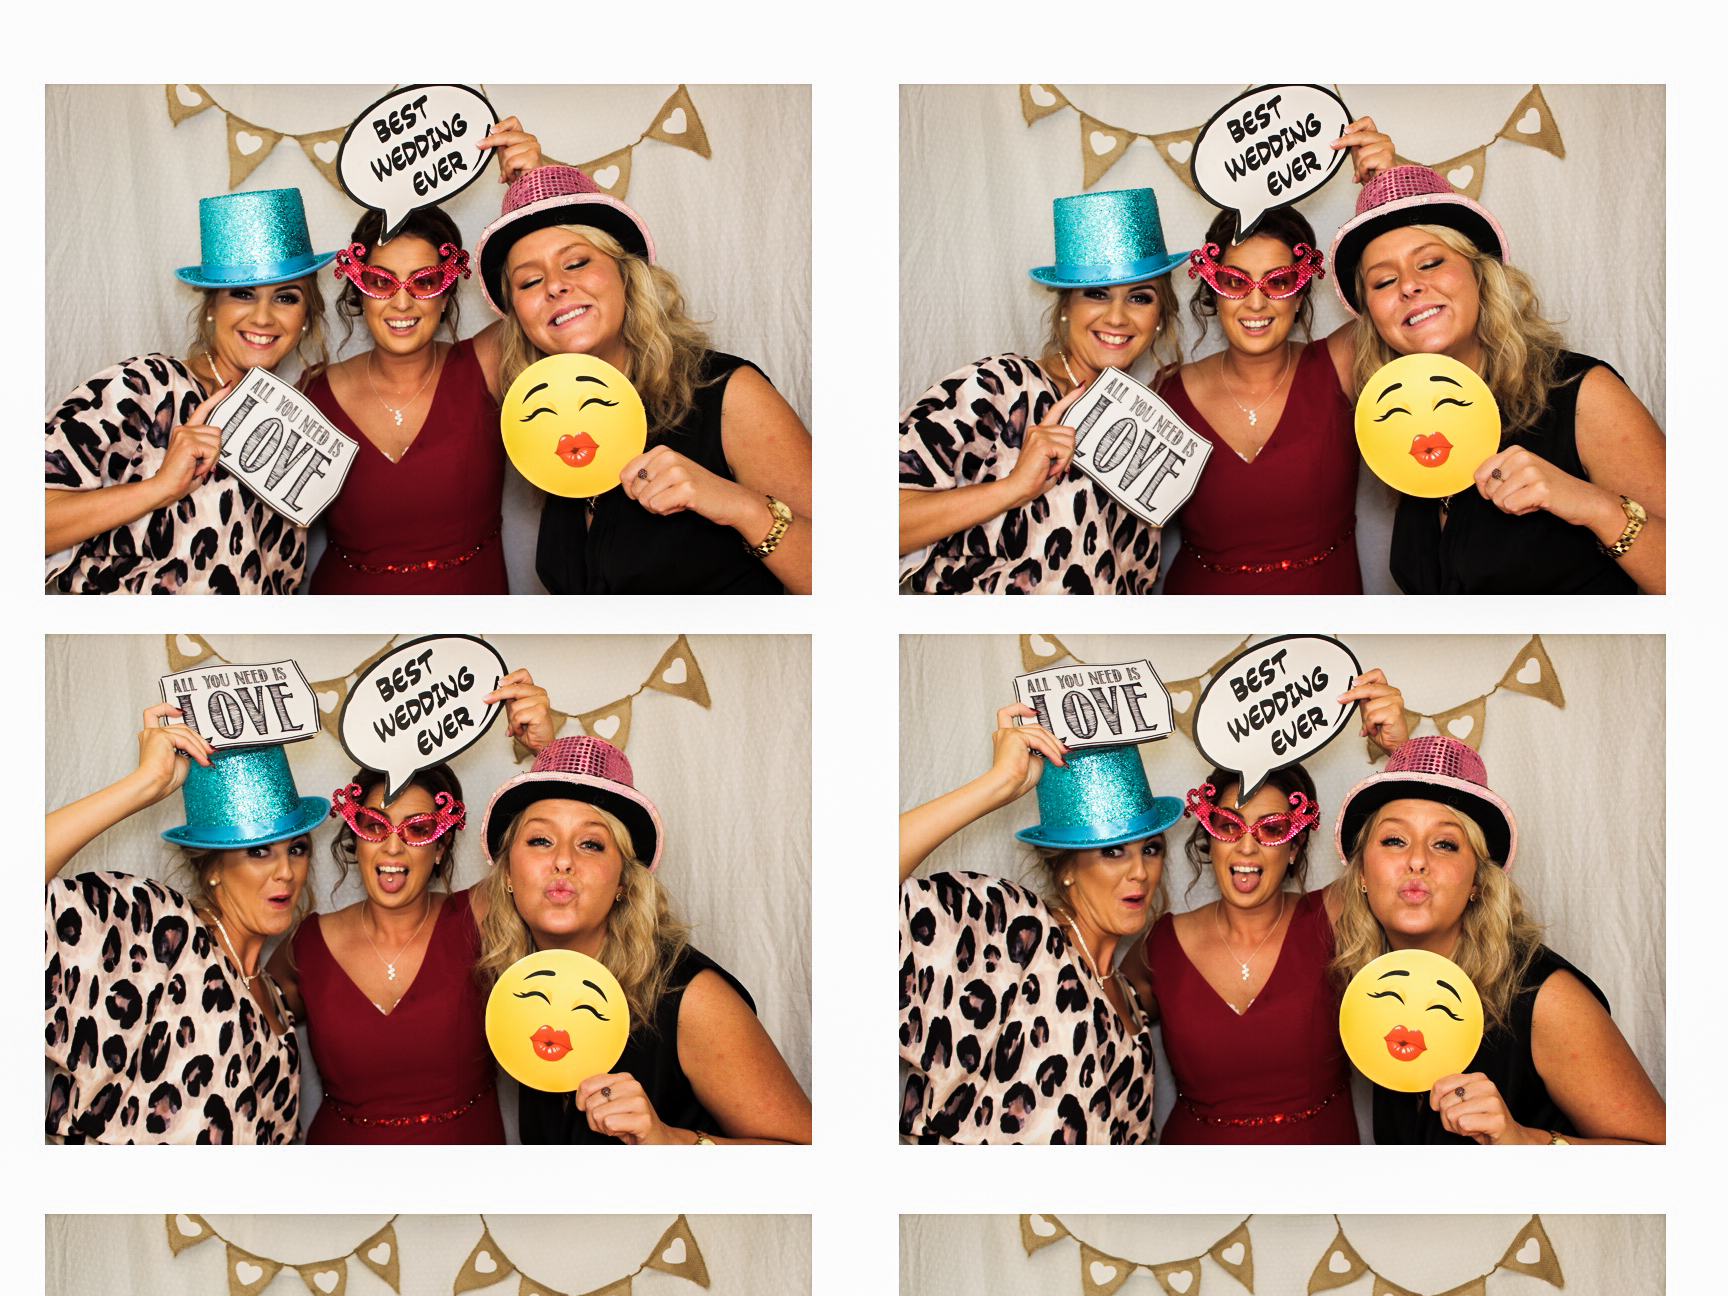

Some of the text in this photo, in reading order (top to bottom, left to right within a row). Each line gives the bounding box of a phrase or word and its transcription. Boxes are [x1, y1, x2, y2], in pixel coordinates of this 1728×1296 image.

[373, 95, 427, 143] BEST
[1227, 95, 1281, 143] BEST
[371, 113, 467, 182] WEDDING
[413, 151, 467, 196] EVER
[1225, 113, 1321, 182] WEDDING
[1267, 151, 1321, 196] EVER
[250, 378, 344, 457] ALL YOU NEED IS
[1104, 378, 1198, 457] ALL YOU NEED IS
[220, 394, 332, 512] LOVE
[1074, 394, 1186, 512] LOVE
[173, 667, 287, 693] ALL YOU NEED IS
[376, 649, 433, 702] BEST
[1027, 667, 1141, 693] ALL YOU NEED IS
[1230, 649, 1287, 702] BEST
[373, 666, 474, 743] WEDDING
[417, 707, 474, 755] EVER
[1227, 666, 1328, 743] WEDDING
[1271, 707, 1328, 755] EVER
